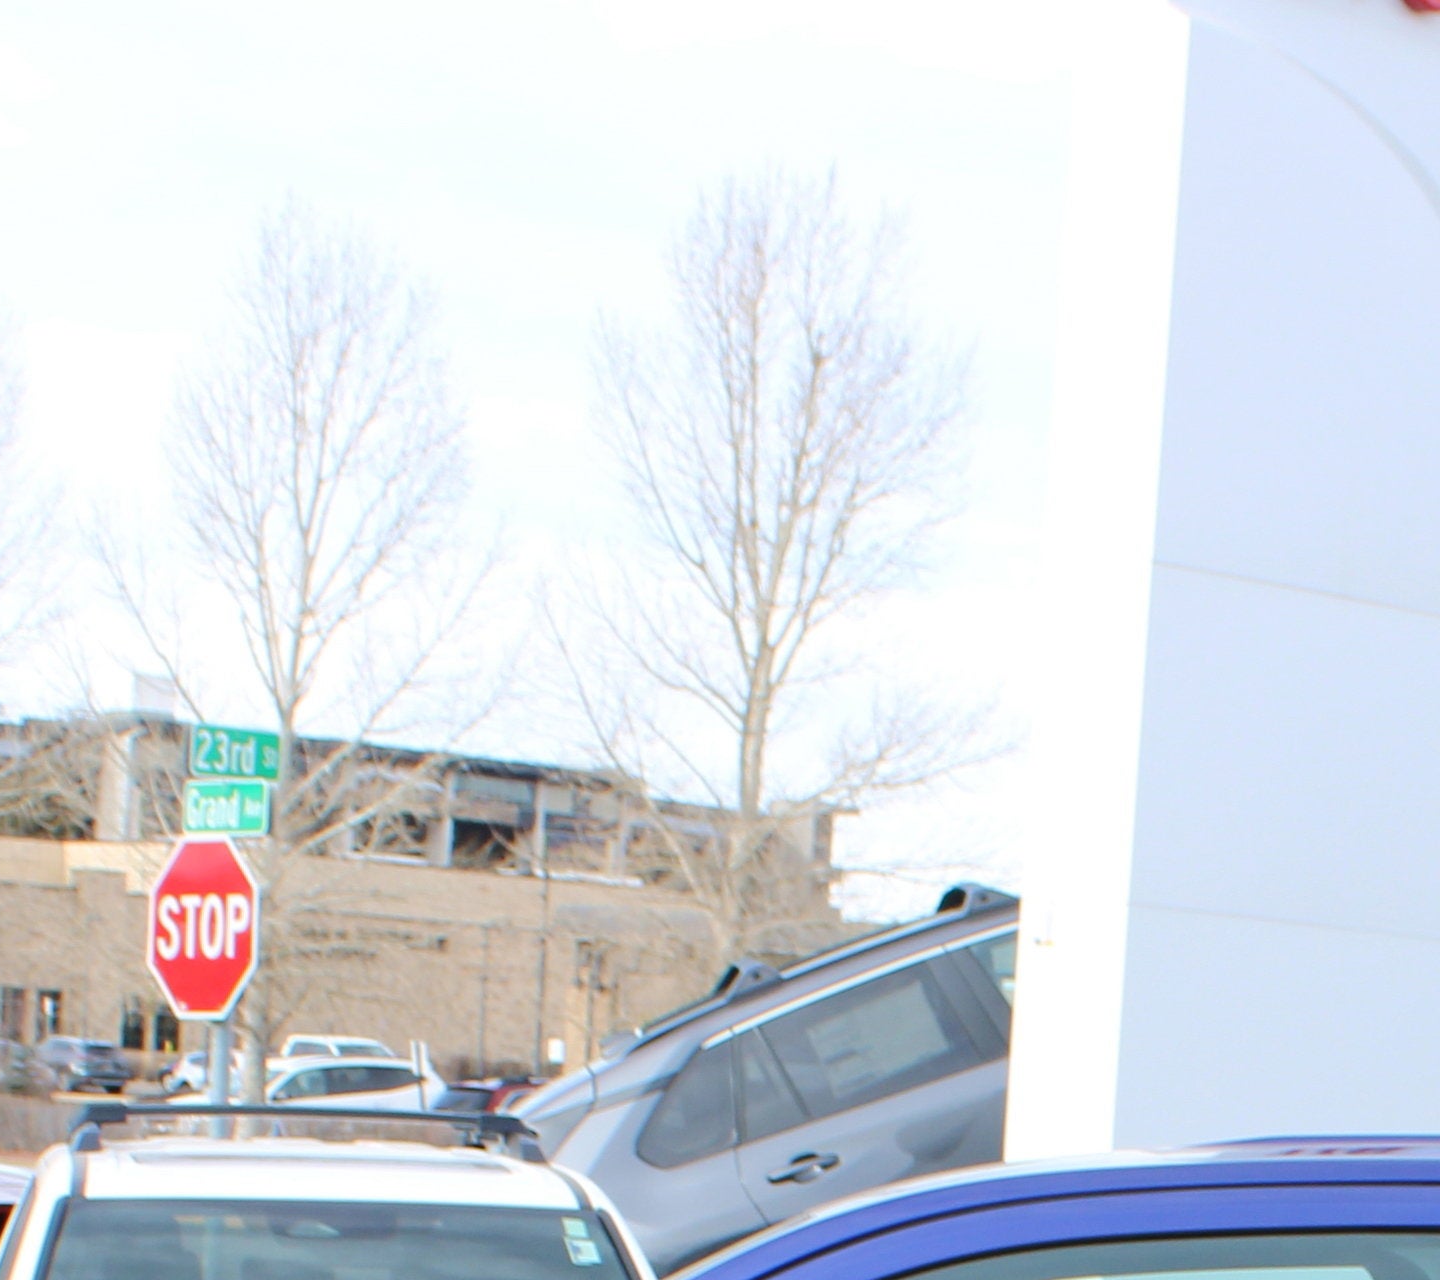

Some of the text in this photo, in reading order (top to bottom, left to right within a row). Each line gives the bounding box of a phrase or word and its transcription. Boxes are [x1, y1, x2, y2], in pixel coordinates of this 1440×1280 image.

[196, 729, 256, 775] 23rd
[186, 788, 239, 829] Grand
[157, 893, 251, 960] STOP
